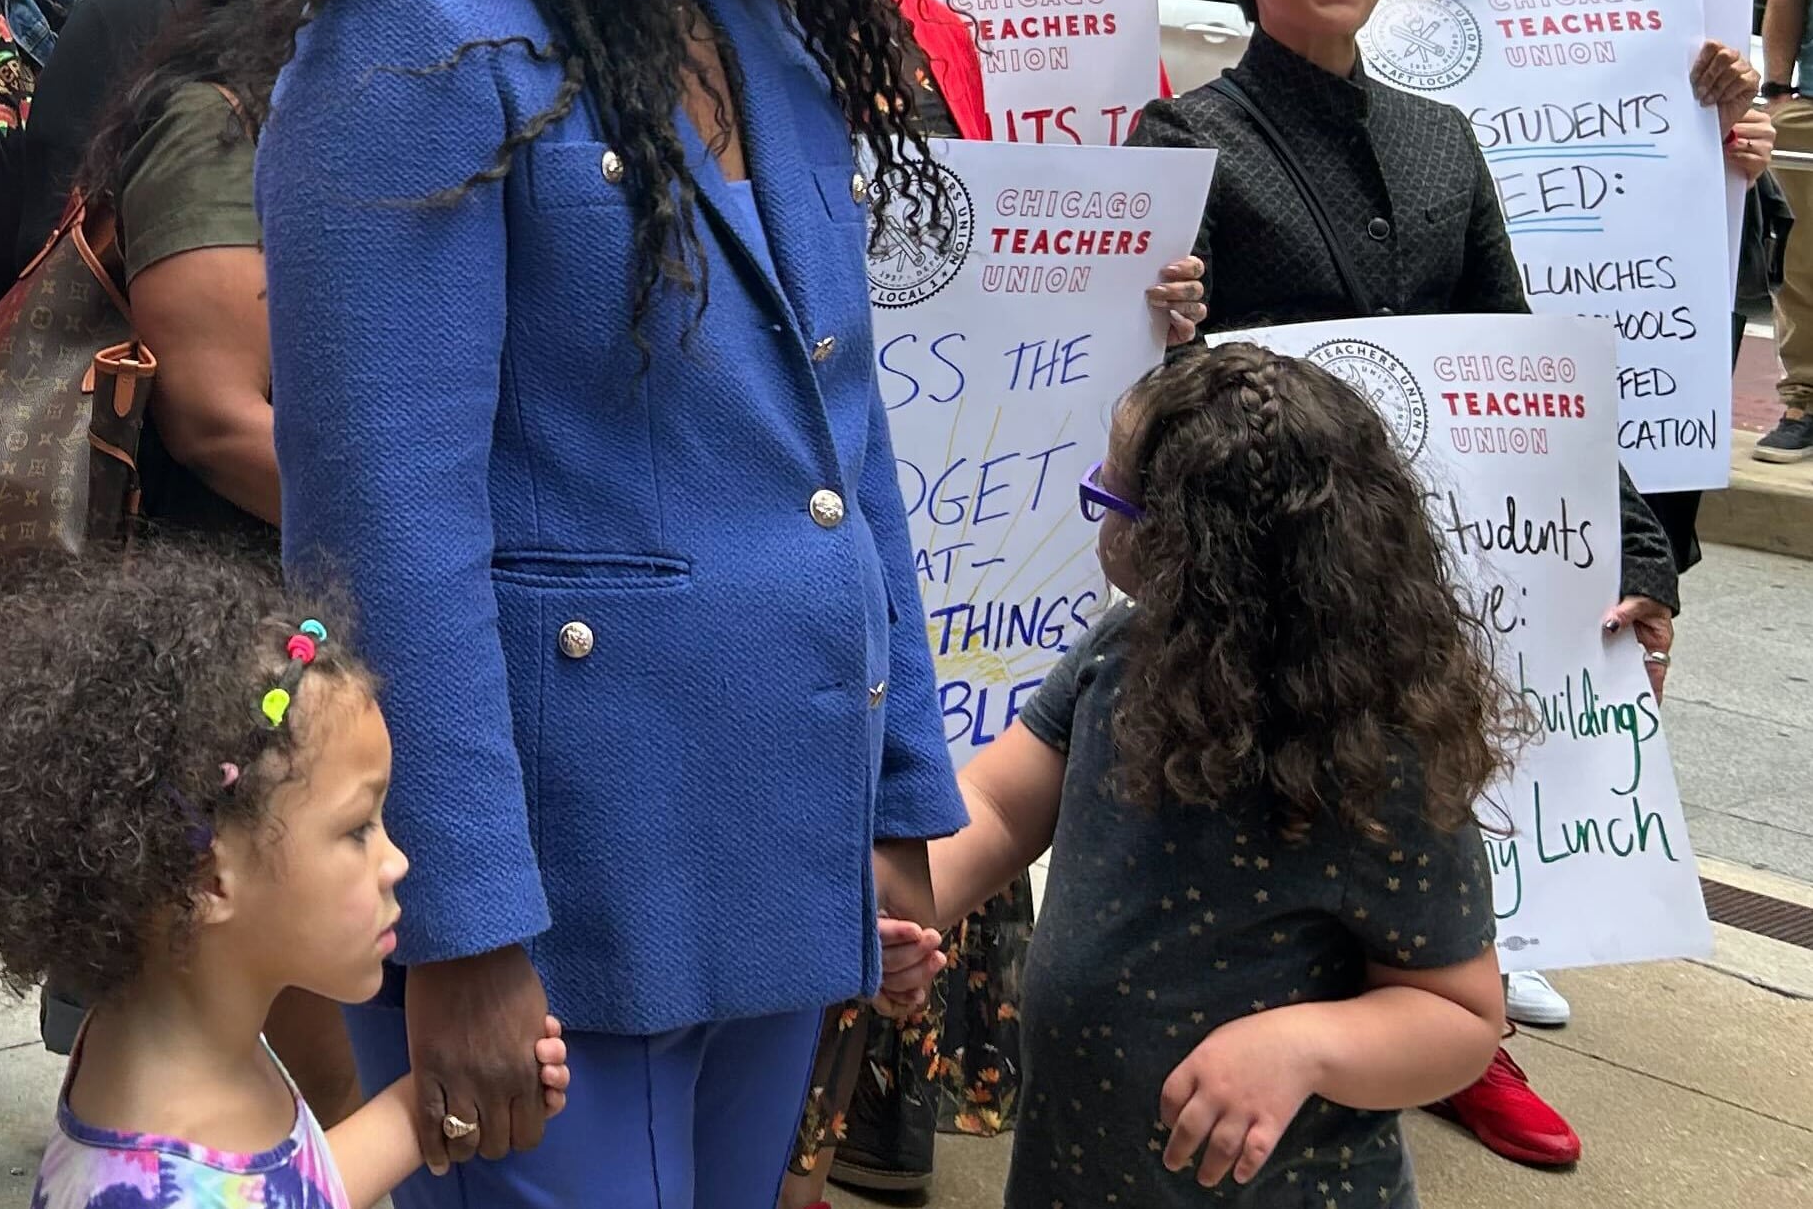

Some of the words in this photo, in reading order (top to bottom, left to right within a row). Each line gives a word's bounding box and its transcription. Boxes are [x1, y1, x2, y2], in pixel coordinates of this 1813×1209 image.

[1454, 8, 1478, 52] UNION
[1495, 9, 1663, 39] TEACHERS
[976, 46, 1068, 74] NION
[1504, 40, 1617, 69] UNION
[1389, 69, 1415, 84] AFT
[1419, 70, 1461, 87] LOCAL
[1469, 92, 1672, 151] STUDENTS
[995, 187, 1152, 221] CHICAGO
[948, 206, 970, 265] UNION
[990, 228, 1152, 256] TEACHERS
[981, 264, 1093, 295] UNION
[1522, 255, 1677, 296] LUNCHES
[877, 287, 926, 303] LOCAL
[1004, 334, 1093, 391] THE
[1433, 354, 1577, 384] CHICAGO
[1315, 344, 1398, 372] TEACHERS
[1400, 375, 1423, 430] UNION
[1441, 391, 1586, 419] TEACHERS
[1451, 426, 1549, 455] UNION
[1518, 651, 1660, 796] buildings
[1533, 780, 1680, 864] Lunch
